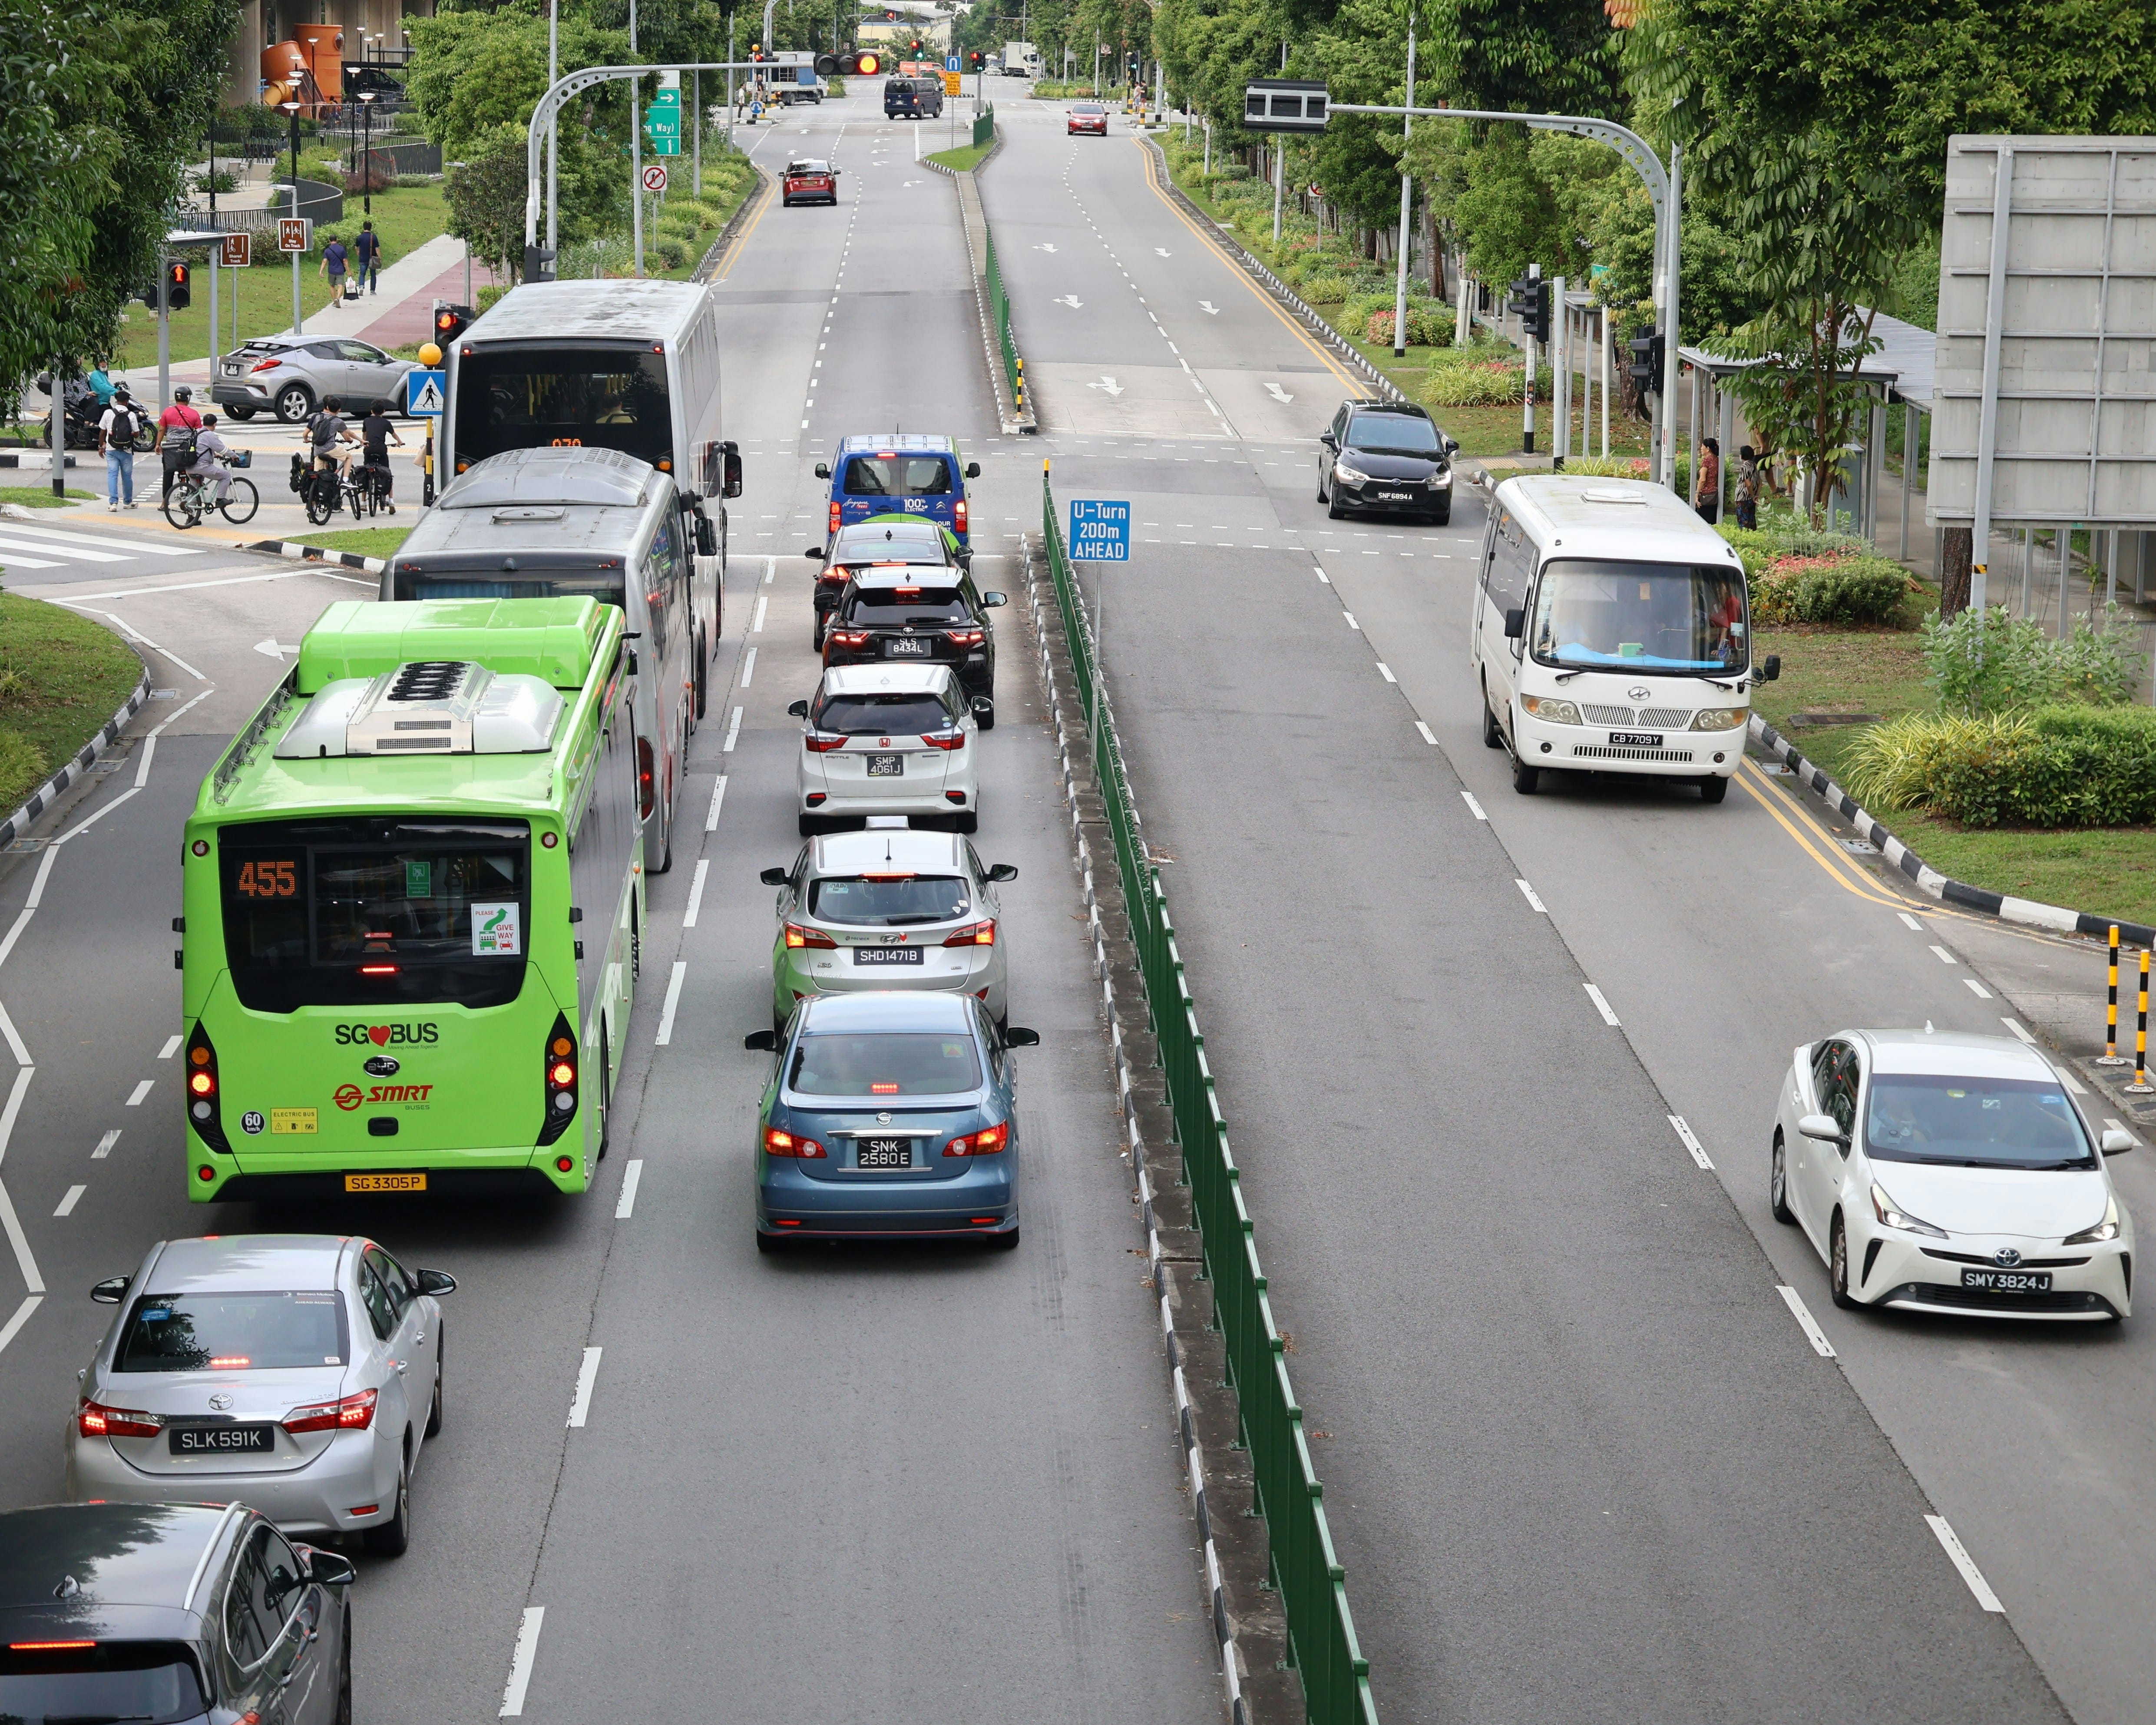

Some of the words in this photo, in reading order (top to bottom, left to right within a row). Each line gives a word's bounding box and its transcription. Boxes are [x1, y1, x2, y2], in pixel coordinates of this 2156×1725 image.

[656, 123, 674, 134] Way)
[842, 498, 869, 508] Singapore
[1075, 503, 1126, 519] U-Turn
[1080, 523, 1119, 539] 200m
[1075, 542, 1124, 559] AHEAD
[876, 757, 895, 765] SMP
[239, 861, 295, 897] 455
[860, 950, 917, 961] SHD1471B
[335, 1024, 369, 1045] SG
[390, 1023, 438, 1043] BUS
[368, 1063, 396, 1071] BYD
[366, 1085, 433, 1102] SMRT
[245, 1114, 261, 1126] 60
[870, 1141, 898, 1152] SNK
